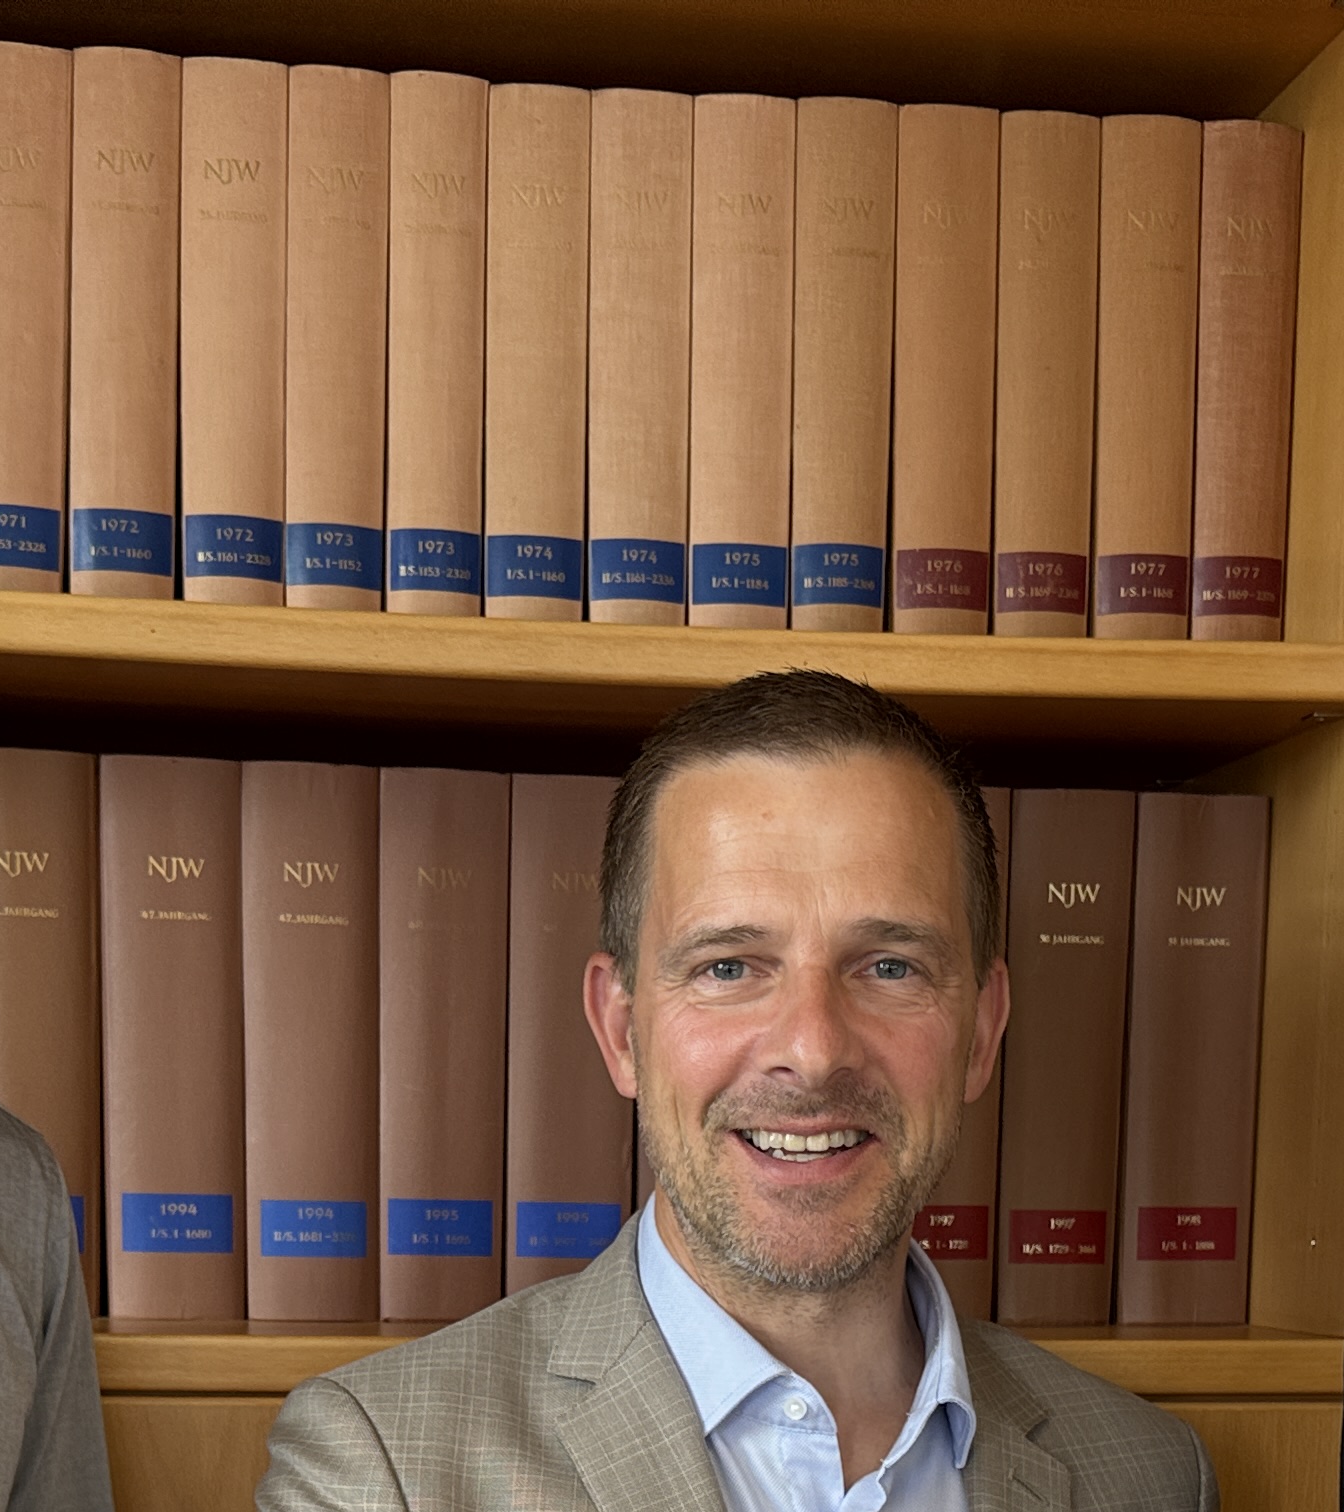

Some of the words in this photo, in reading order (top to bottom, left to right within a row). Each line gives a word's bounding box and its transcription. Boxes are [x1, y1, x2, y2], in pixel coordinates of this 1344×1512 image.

[97, 148, 154, 175] NJW
[203, 158, 261, 185] NJW
[412, 173, 465, 199] NJW
[101, 518, 139, 534] 1972
[215, 527, 254, 543] 1972
[316, 531, 354, 547] 1973
[418, 540, 455, 556] 1973
[516, 545, 552, 560] 1974
[622, 549, 657, 564] 1974
[724, 552, 760, 567] 1975
[823, 553, 859, 568] 1975
[927, 559, 963, 574] 1976
[1027, 562, 1063, 577] 1976
[1130, 562, 1166, 577] 1977
[1224, 565, 1261, 580] 1977
[148, 855, 205, 883] NJW
[283, 862, 340, 888] NJW
[417, 866, 472, 891] NJW
[1047, 882, 1101, 909] NJW
[1176, 886, 1227, 912] NJW
[160, 1203, 198, 1216] 1994
[297, 1207, 334, 1220] 1994
[425, 1209, 459, 1221] 1995
